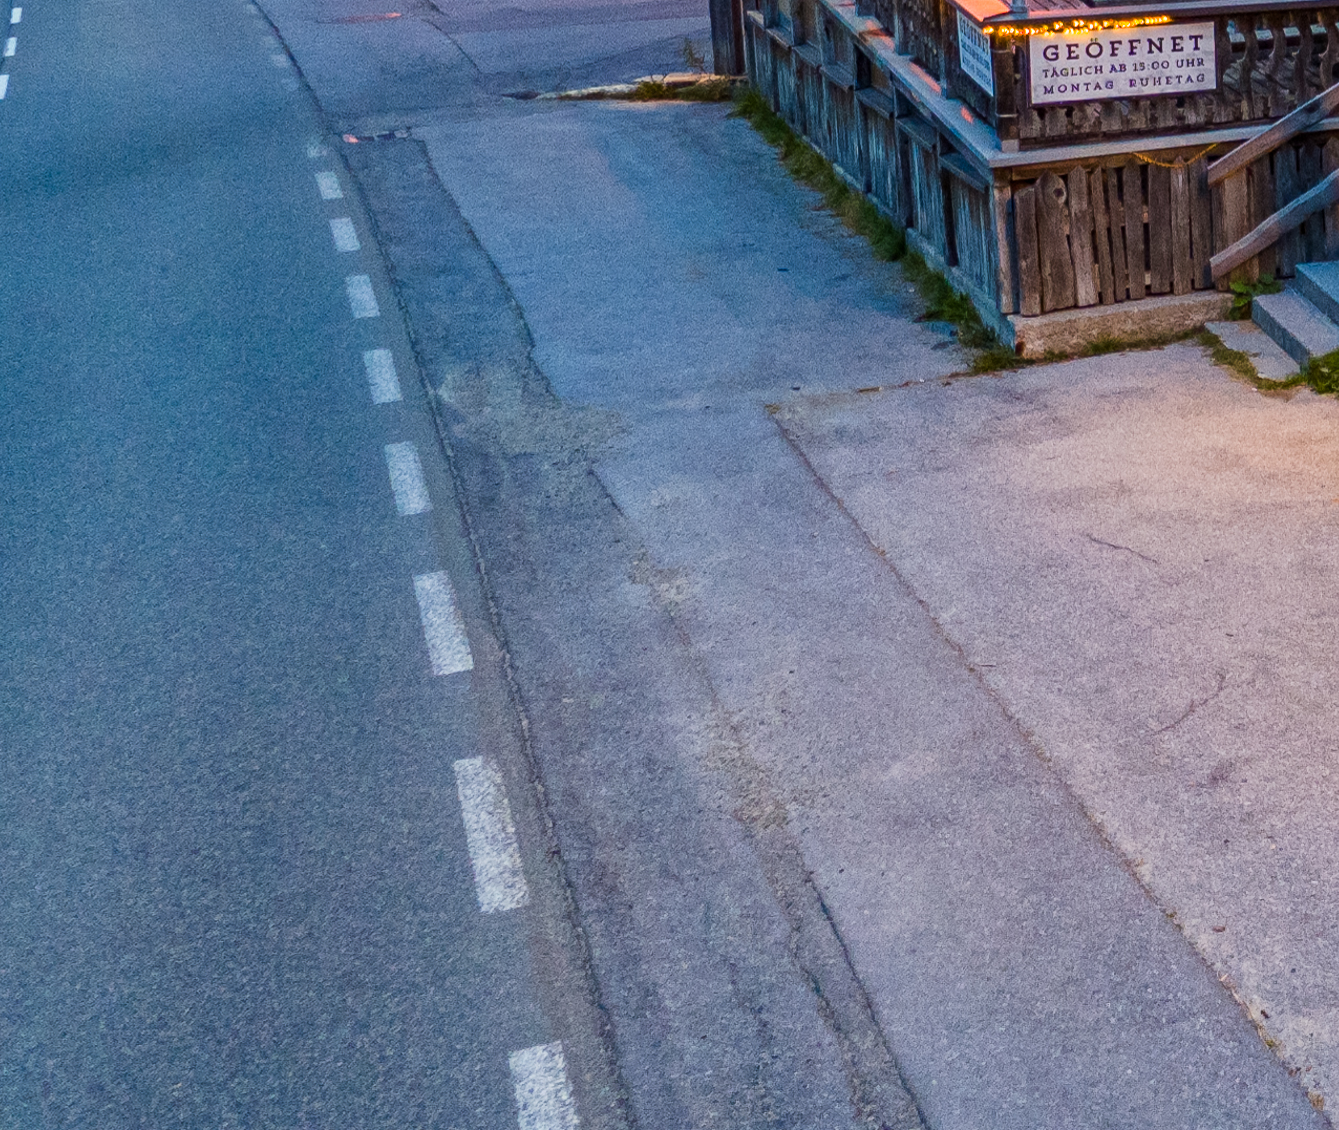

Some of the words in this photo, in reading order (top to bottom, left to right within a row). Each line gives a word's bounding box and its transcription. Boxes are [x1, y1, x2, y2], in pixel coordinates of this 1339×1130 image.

[1043, 35, 1204, 62] GEÖFFNET
[1042, 64, 1104, 79] TÄGLICH
[1109, 63, 1127, 74] AB
[1132, 60, 1170, 73] 15:00
[1176, 57, 1205, 69] UHR
[1043, 80, 1114, 95] MONTAG
[1129, 73, 1205, 88] RUHETAG
